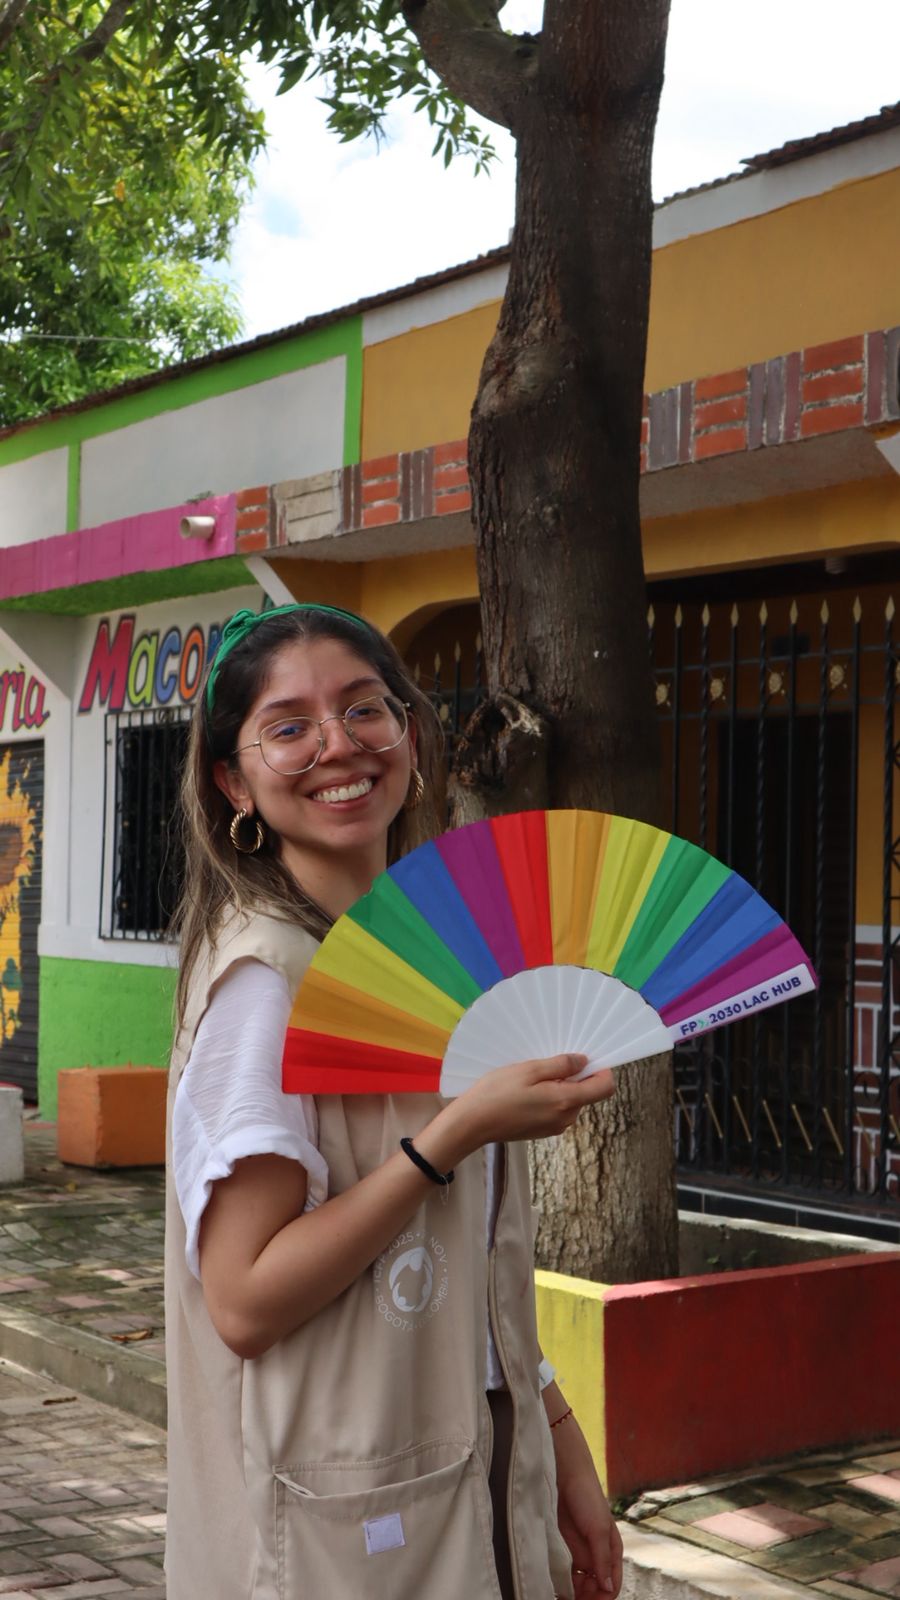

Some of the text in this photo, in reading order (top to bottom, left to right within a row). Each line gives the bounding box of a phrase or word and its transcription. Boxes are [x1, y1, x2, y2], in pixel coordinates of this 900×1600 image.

[709, 1003, 742, 1024] 2030
[743, 991, 769, 1009] LAC
[772, 976, 801, 997] HUB
